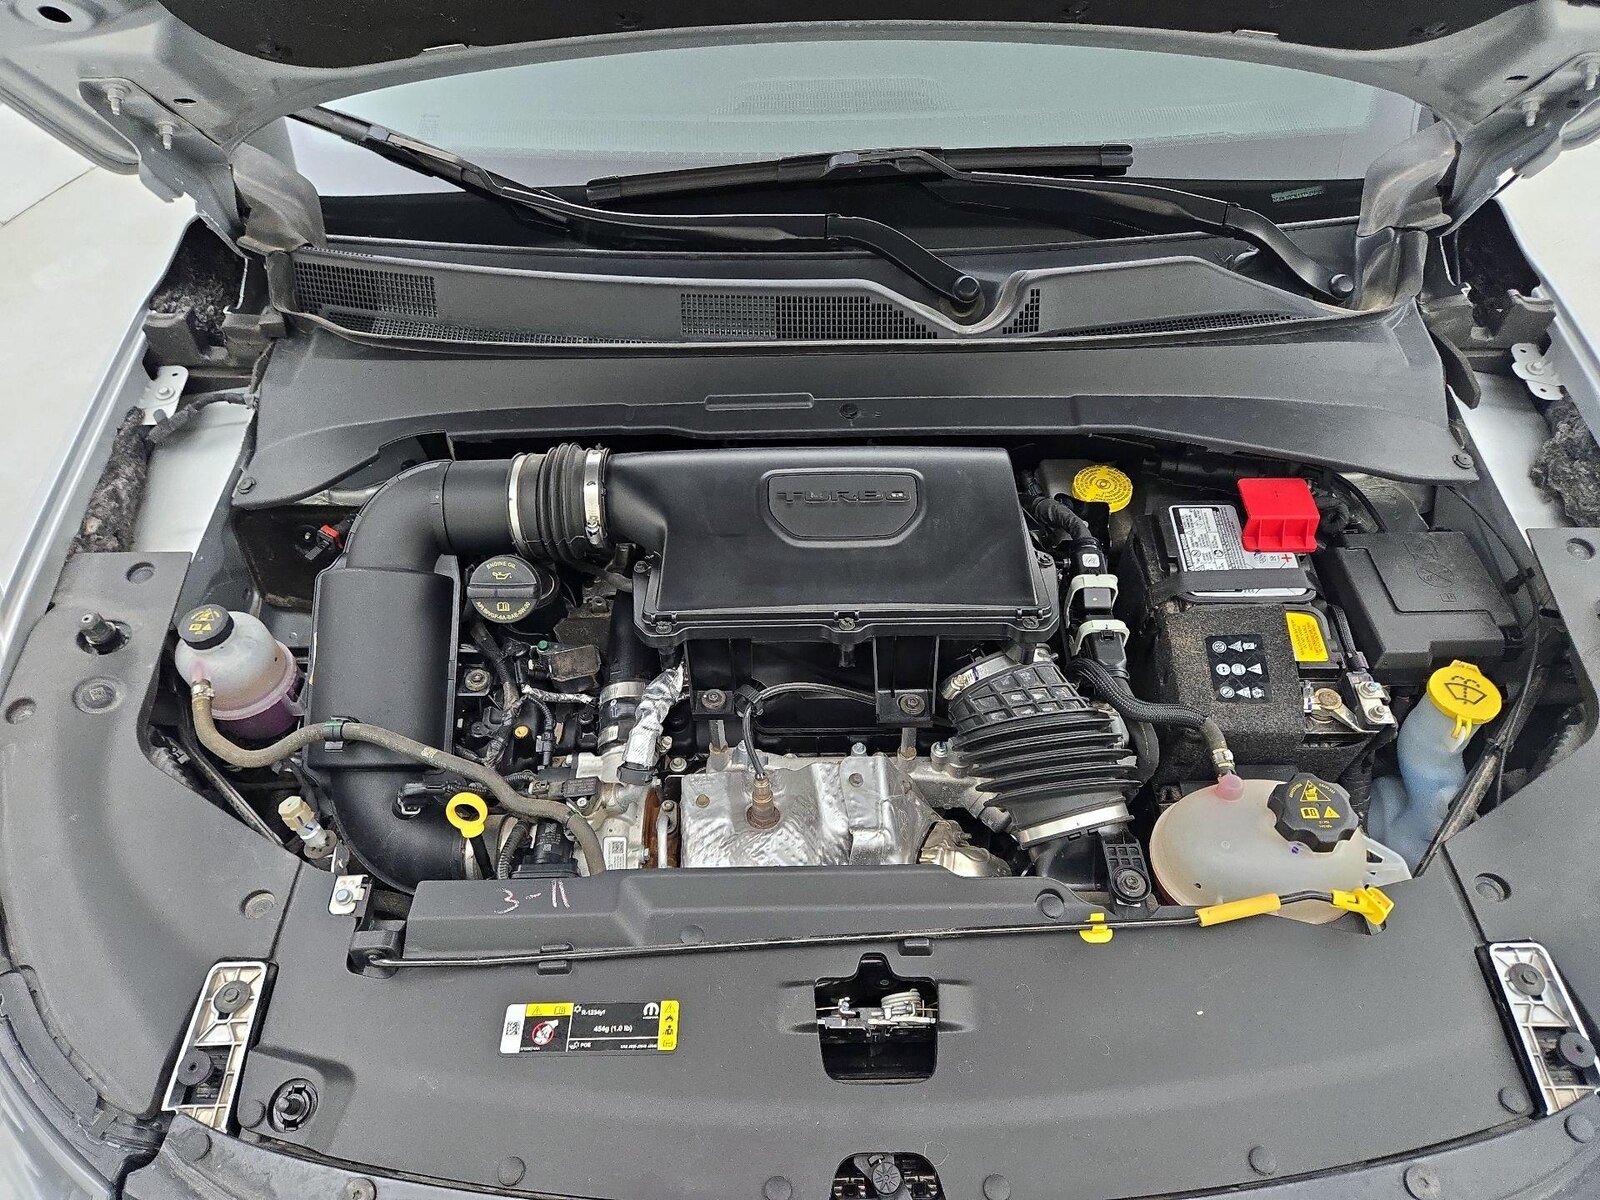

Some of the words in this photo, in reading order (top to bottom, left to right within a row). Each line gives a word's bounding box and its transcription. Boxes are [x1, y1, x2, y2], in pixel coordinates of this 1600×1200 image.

[777, 490, 911, 505] TURBO
[486, 561, 507, 570] ENGINE
[507, 562, 517, 570] OIL
[581, 1008, 606, 1017] R-1234yf
[593, 1025, 610, 1034] 454g
[610, 1025, 623, 1033] (1.0
[623, 1024, 633, 1033] lb)
